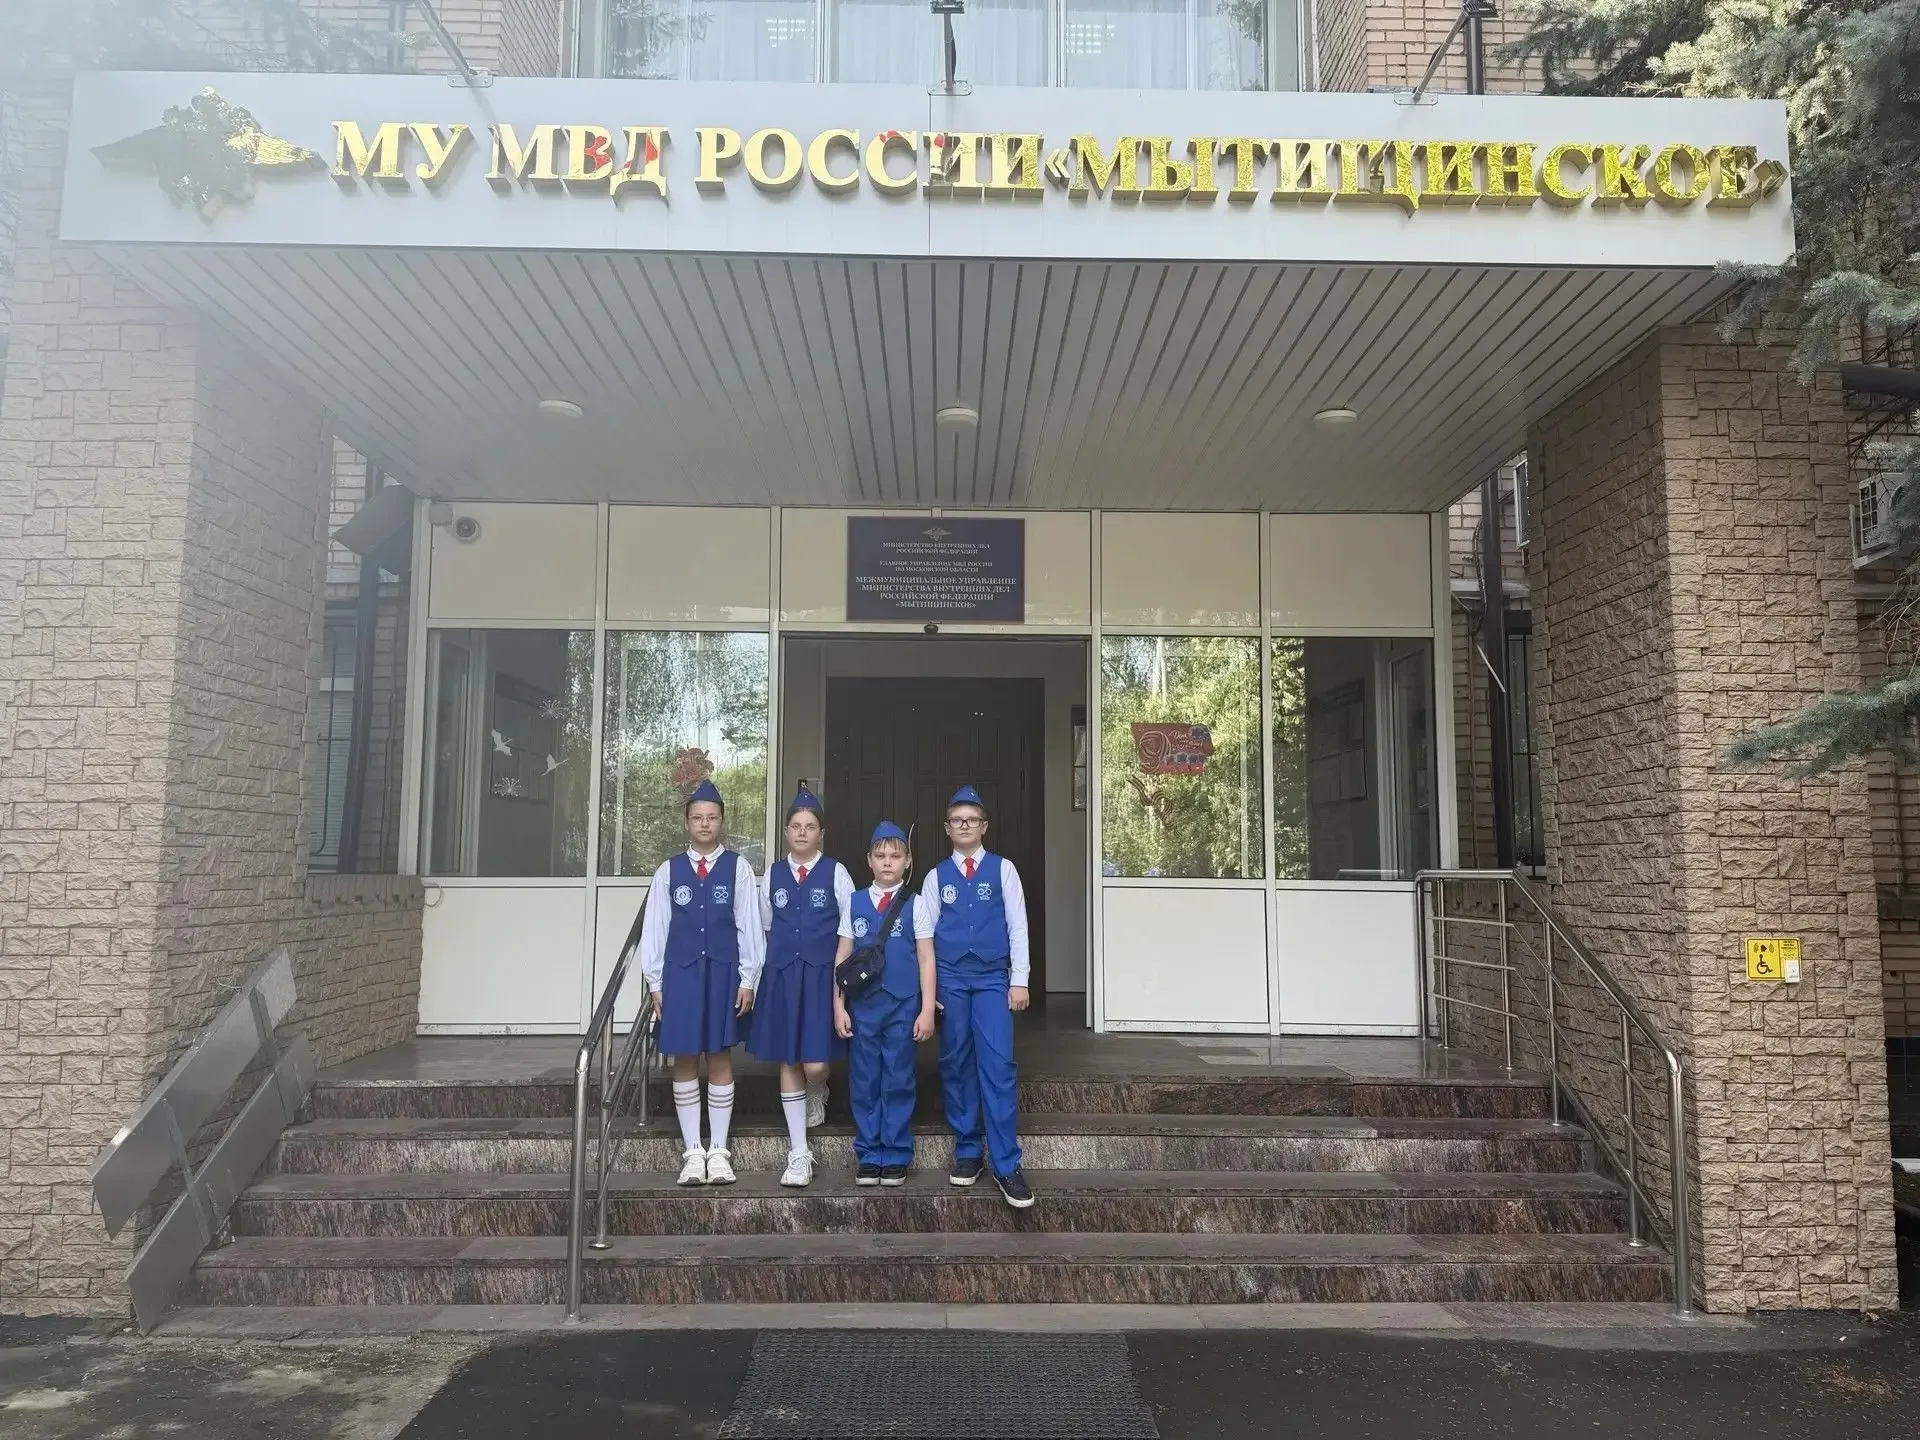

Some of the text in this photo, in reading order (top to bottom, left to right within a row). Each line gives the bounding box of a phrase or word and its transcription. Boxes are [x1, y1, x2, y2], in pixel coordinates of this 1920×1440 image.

[330, 120, 478, 187] МУ
[484, 124, 671, 199] МВД
[694, 127, 1045, 195] РОССИИ
[856, 576, 1017, 585] МЕЖМУНИЦИПАЛЬНОЕ УПРАВЛЕНИЕ
[861, 584, 931, 592] МИНИСТЕРСТВА
[992, 585, 1010, 593] ДЕЛ
[880, 592, 994, 600] РОССИЙСКОЙ ФЕДЕРАЦИИ
